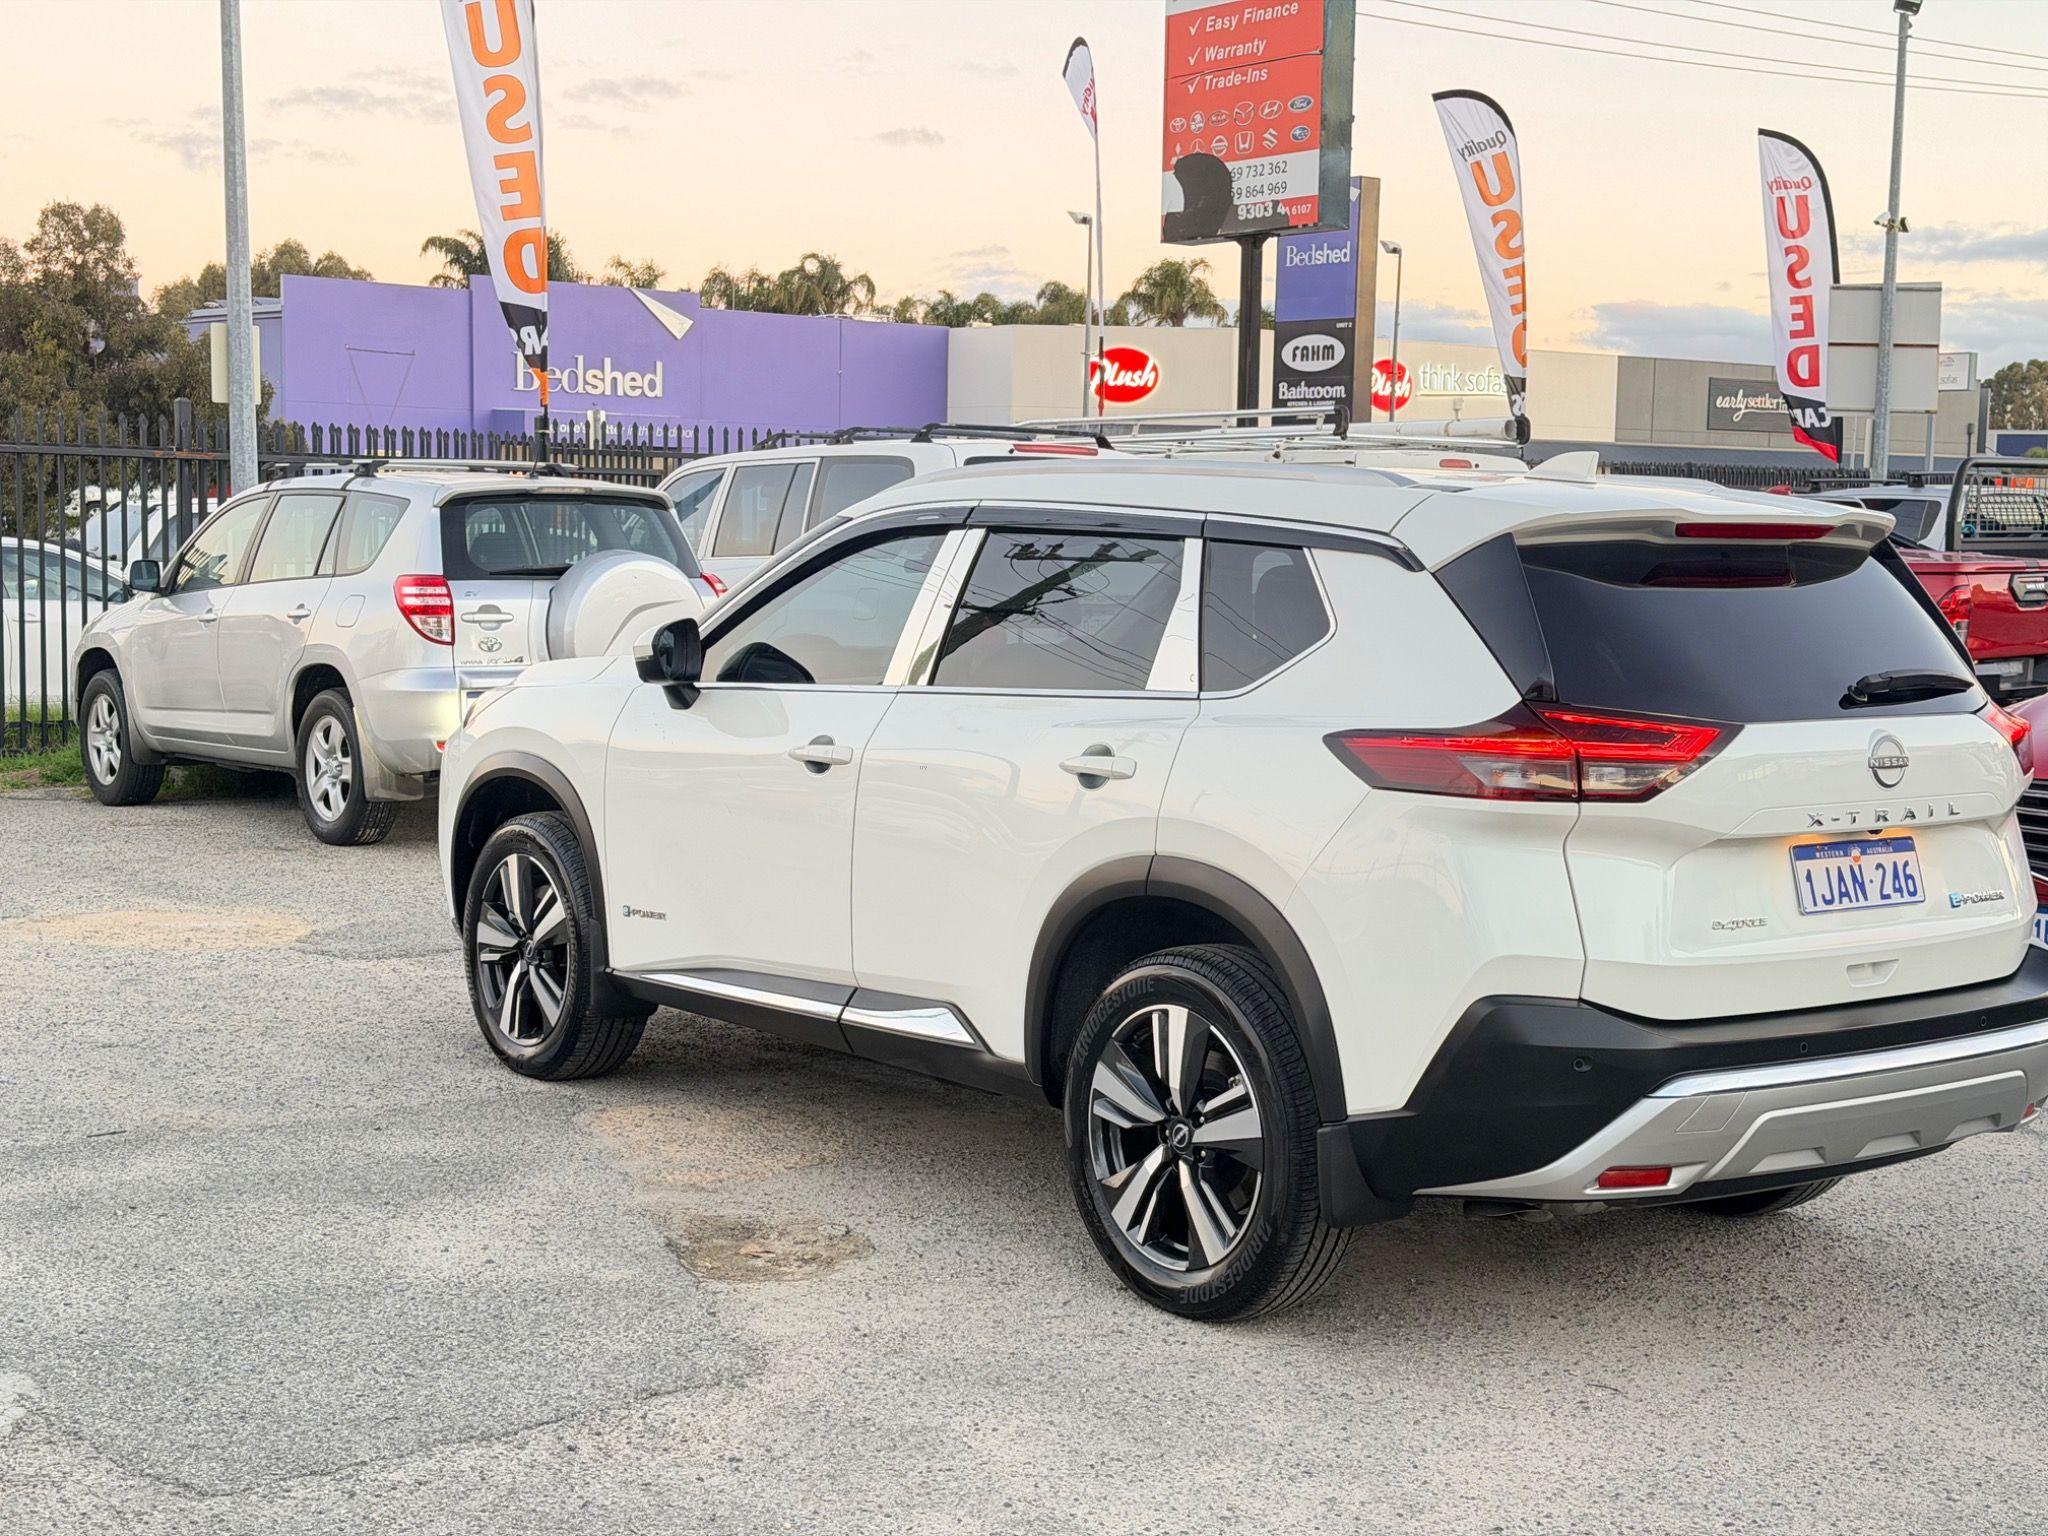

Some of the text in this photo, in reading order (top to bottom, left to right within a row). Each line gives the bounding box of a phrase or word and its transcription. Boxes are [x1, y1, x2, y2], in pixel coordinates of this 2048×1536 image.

[1205, 2, 1299, 32] Easy Finance
[1204, 38, 1267, 62] Warranty
[1204, 68, 1268, 91] Trade-Ins
[1246, 164, 1265, 178] 732
[1269, 160, 1288, 175] 362
[1245, 184, 1265, 198] 864
[1268, 181, 1288, 196] 969
[1237, 201, 1273, 221] 9303
[1285, 240, 1351, 267] Bedshed
[1292, 344, 1335, 362] FAHM
[1089, 356, 1157, 395] Plush
[1419, 361, 1461, 392] think
[1278, 380, 1347, 400] Bathroom
[1869, 757, 1909, 768] NISSAN
[1807, 801, 1961, 828] X-TRAIL
